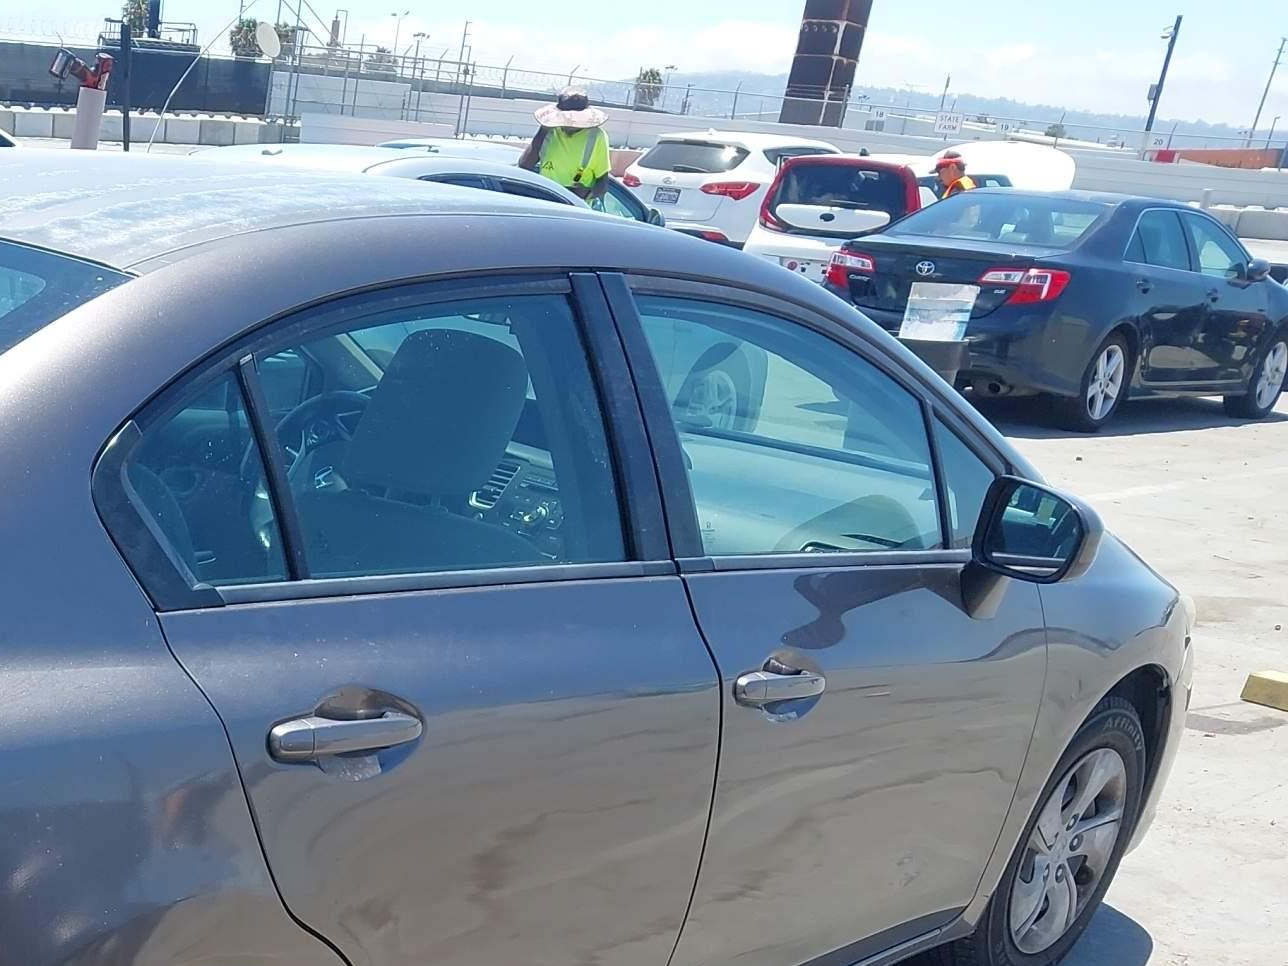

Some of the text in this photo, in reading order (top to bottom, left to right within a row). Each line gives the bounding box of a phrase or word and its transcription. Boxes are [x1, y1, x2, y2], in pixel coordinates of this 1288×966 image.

[938, 114, 960, 122] STATE
[938, 123, 957, 131] FARM
[1102, 715, 1143, 752] Affinity
